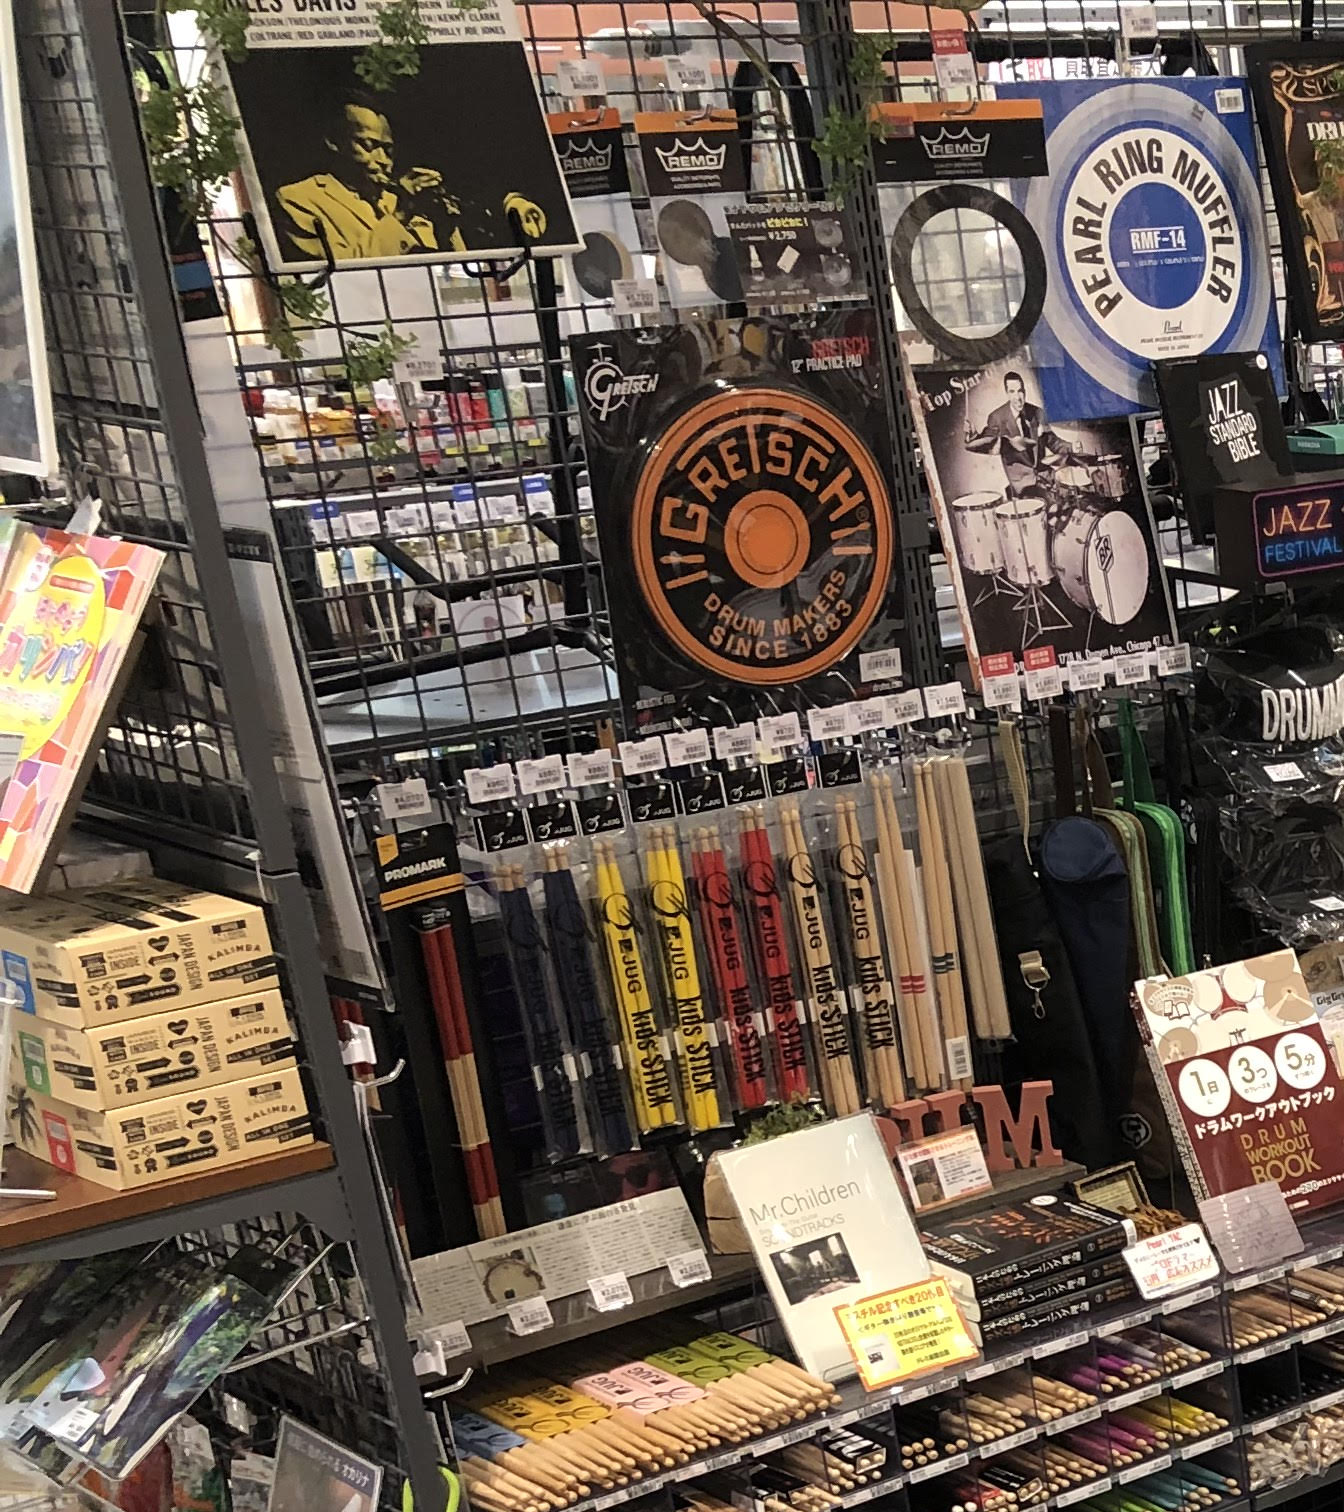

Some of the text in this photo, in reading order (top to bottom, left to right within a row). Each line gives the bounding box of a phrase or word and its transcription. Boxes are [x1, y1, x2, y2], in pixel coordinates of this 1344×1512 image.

[564, 155, 605, 170] REMO
[667, 154, 718, 169] REMO
[932, 142, 983, 156] REMO
[1072, 137, 1236, 319] PEARL RING MUFFLER
[1130, 229, 1187, 252] RMF-14
[806, 355, 844, 372] PRACTICE
[845, 354, 862, 368] PAD
[949, 370, 983, 396] Star
[1207, 380, 1243, 425] JAZZ
[1209, 412, 1258, 446] STANDARD
[1228, 433, 1261, 463] BIBLE
[659, 414, 867, 544] GRETSCH
[1262, 498, 1333, 538] JAZZ
[1264, 535, 1343, 564] FESTIVAL
[704, 570, 846, 637] DRUM MAKERS
[708, 600, 853, 660] SINCE 1883
[384, 856, 447, 884] PROMARK
[177, 932, 204, 992] JAPAN DESIGN
[207, 944, 262, 963] KALIMBA
[226, 1025, 280, 1045] KALIMBA
[818, 1004, 850, 1061] STICK
[865, 997, 896, 1051] STICK
[196, 1016, 222, 1074] JAPAN DESIGN
[738, 1026, 767, 1084] STICK
[778, 1015, 807, 1072] STICK
[1284, 1042, 1316, 1071] 5分
[642, 1052, 675, 1109] STICK
[687, 1040, 717, 1095] STICK
[214, 1096, 241, 1152] JAPAN DESIGN
[243, 1104, 297, 1124] KALIMBA
[1194, 1085, 1336, 1140] ドラムワークアウトブック
[1240, 1116, 1308, 1150] DRUM
[1245, 1133, 1312, 1167] WORKOUT
[1252, 1148, 1322, 1185] BOOK
[749, 1177, 861, 1228] Mr.Children
